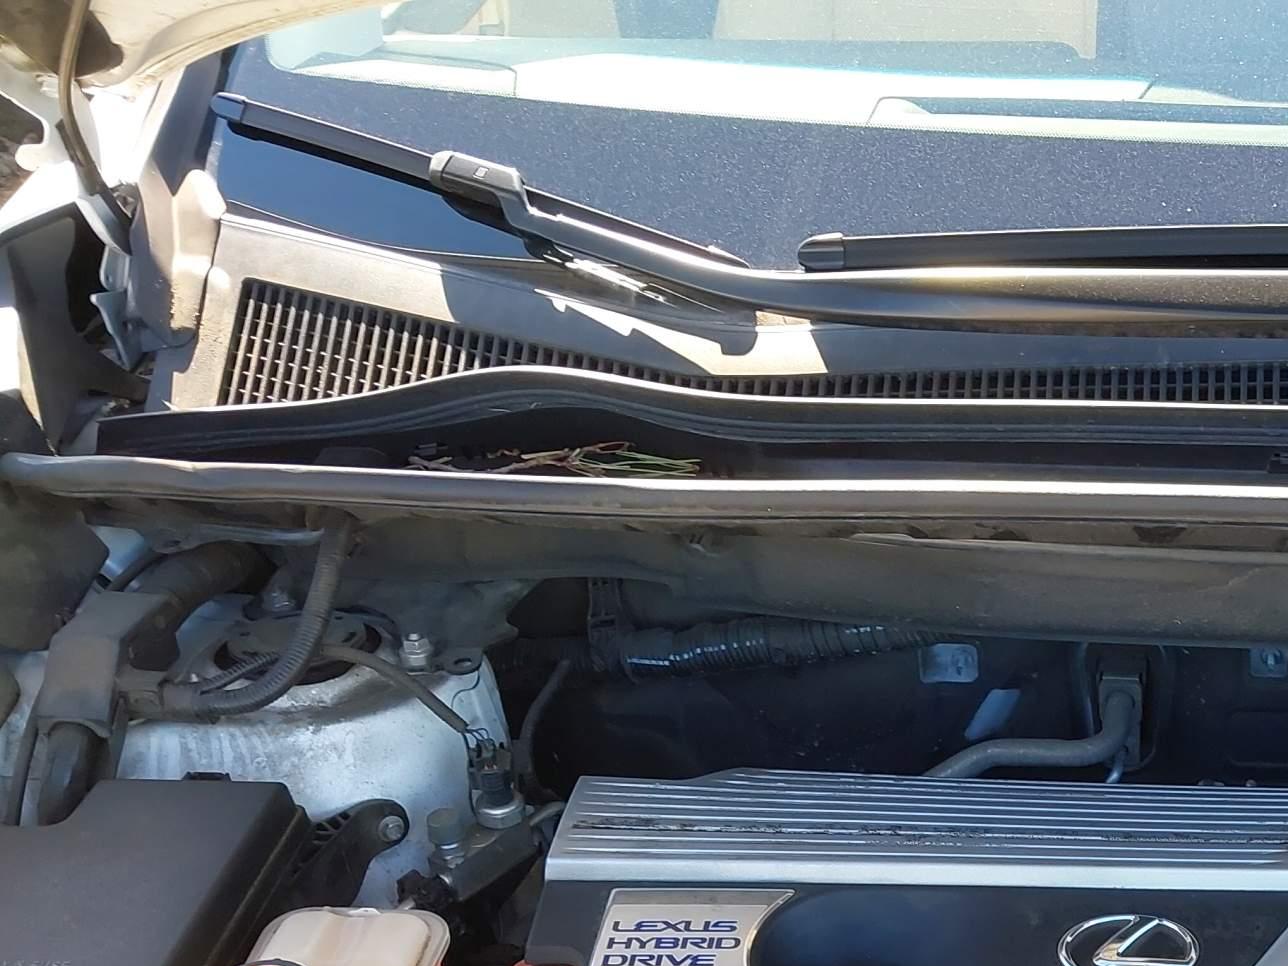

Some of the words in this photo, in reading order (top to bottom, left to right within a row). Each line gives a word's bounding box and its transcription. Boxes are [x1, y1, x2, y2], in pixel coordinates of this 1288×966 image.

[612, 920, 738, 933] LEXUS
[606, 937, 741, 950] HYBRID
[600, 954, 717, 966] DRIVE
